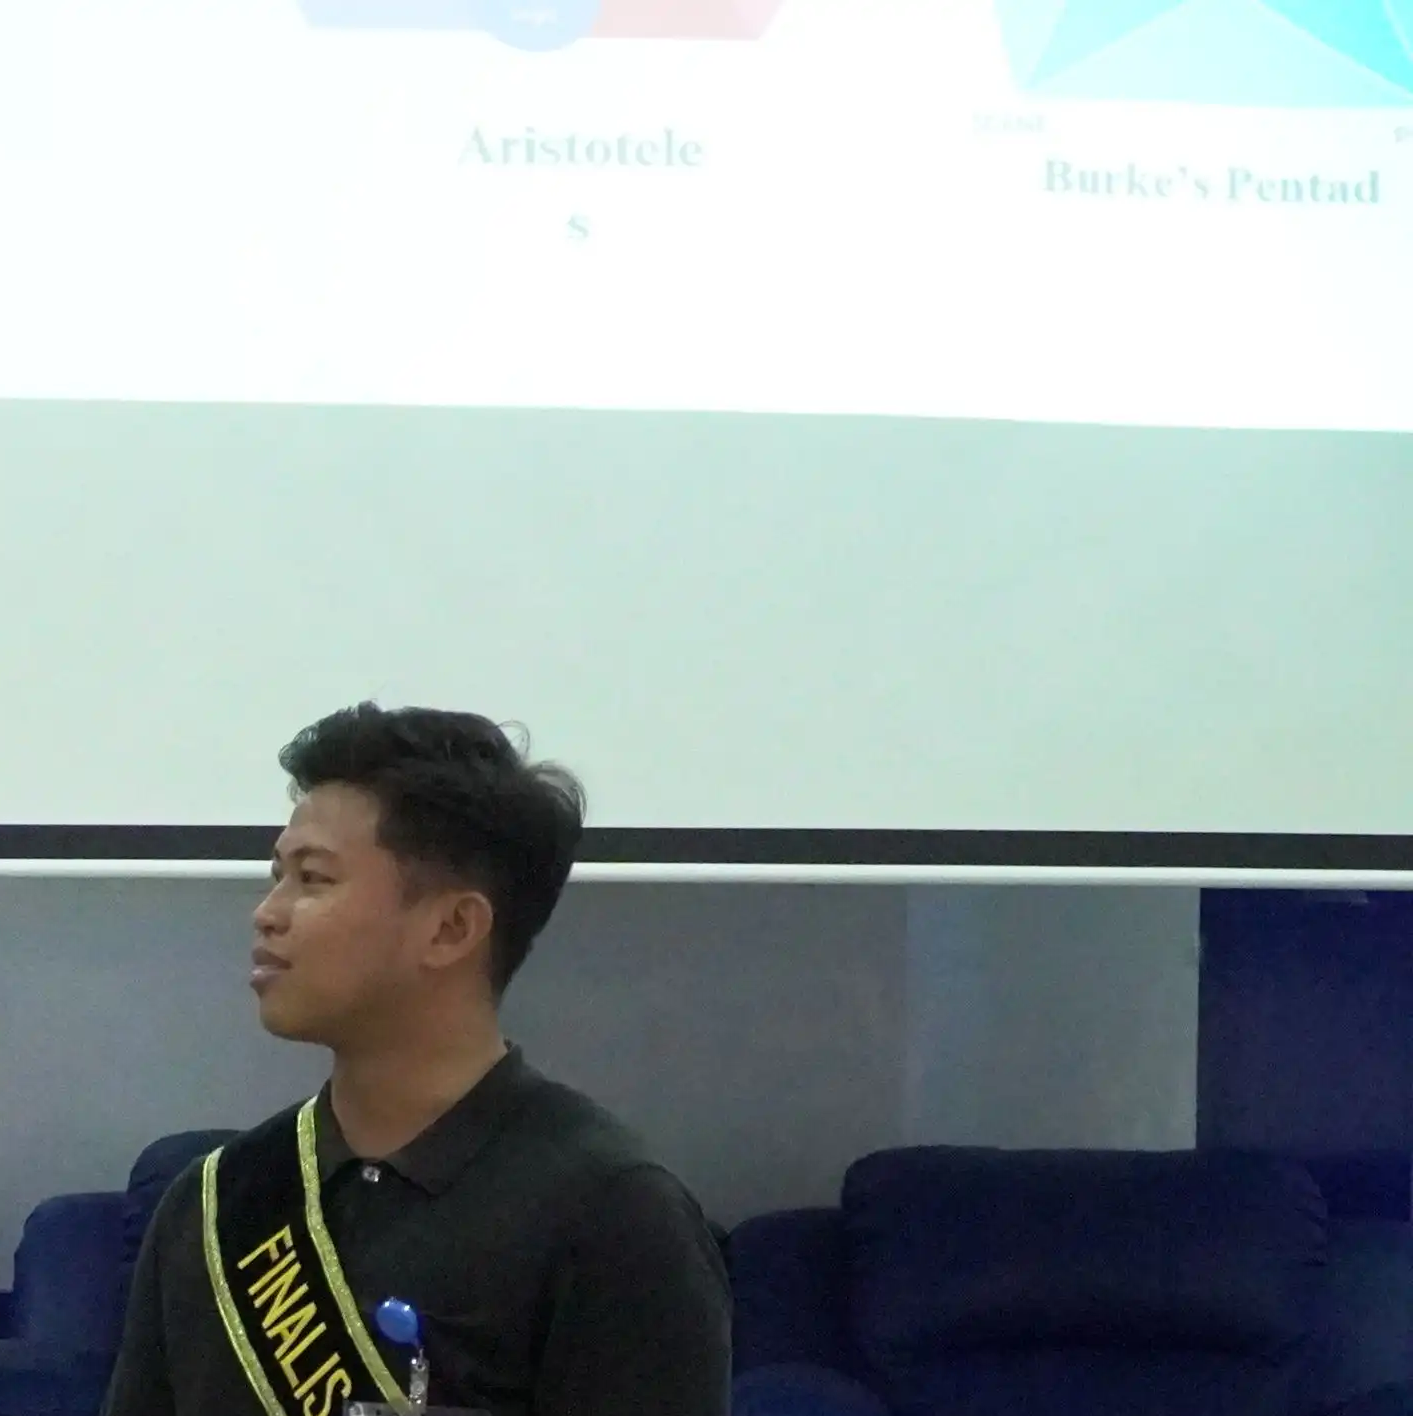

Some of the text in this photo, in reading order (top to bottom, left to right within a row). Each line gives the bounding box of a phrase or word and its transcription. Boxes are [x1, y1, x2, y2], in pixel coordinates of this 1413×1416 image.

[458, 124, 702, 167] Aristotele
[1043, 157, 1380, 205] Burke's Pentad
